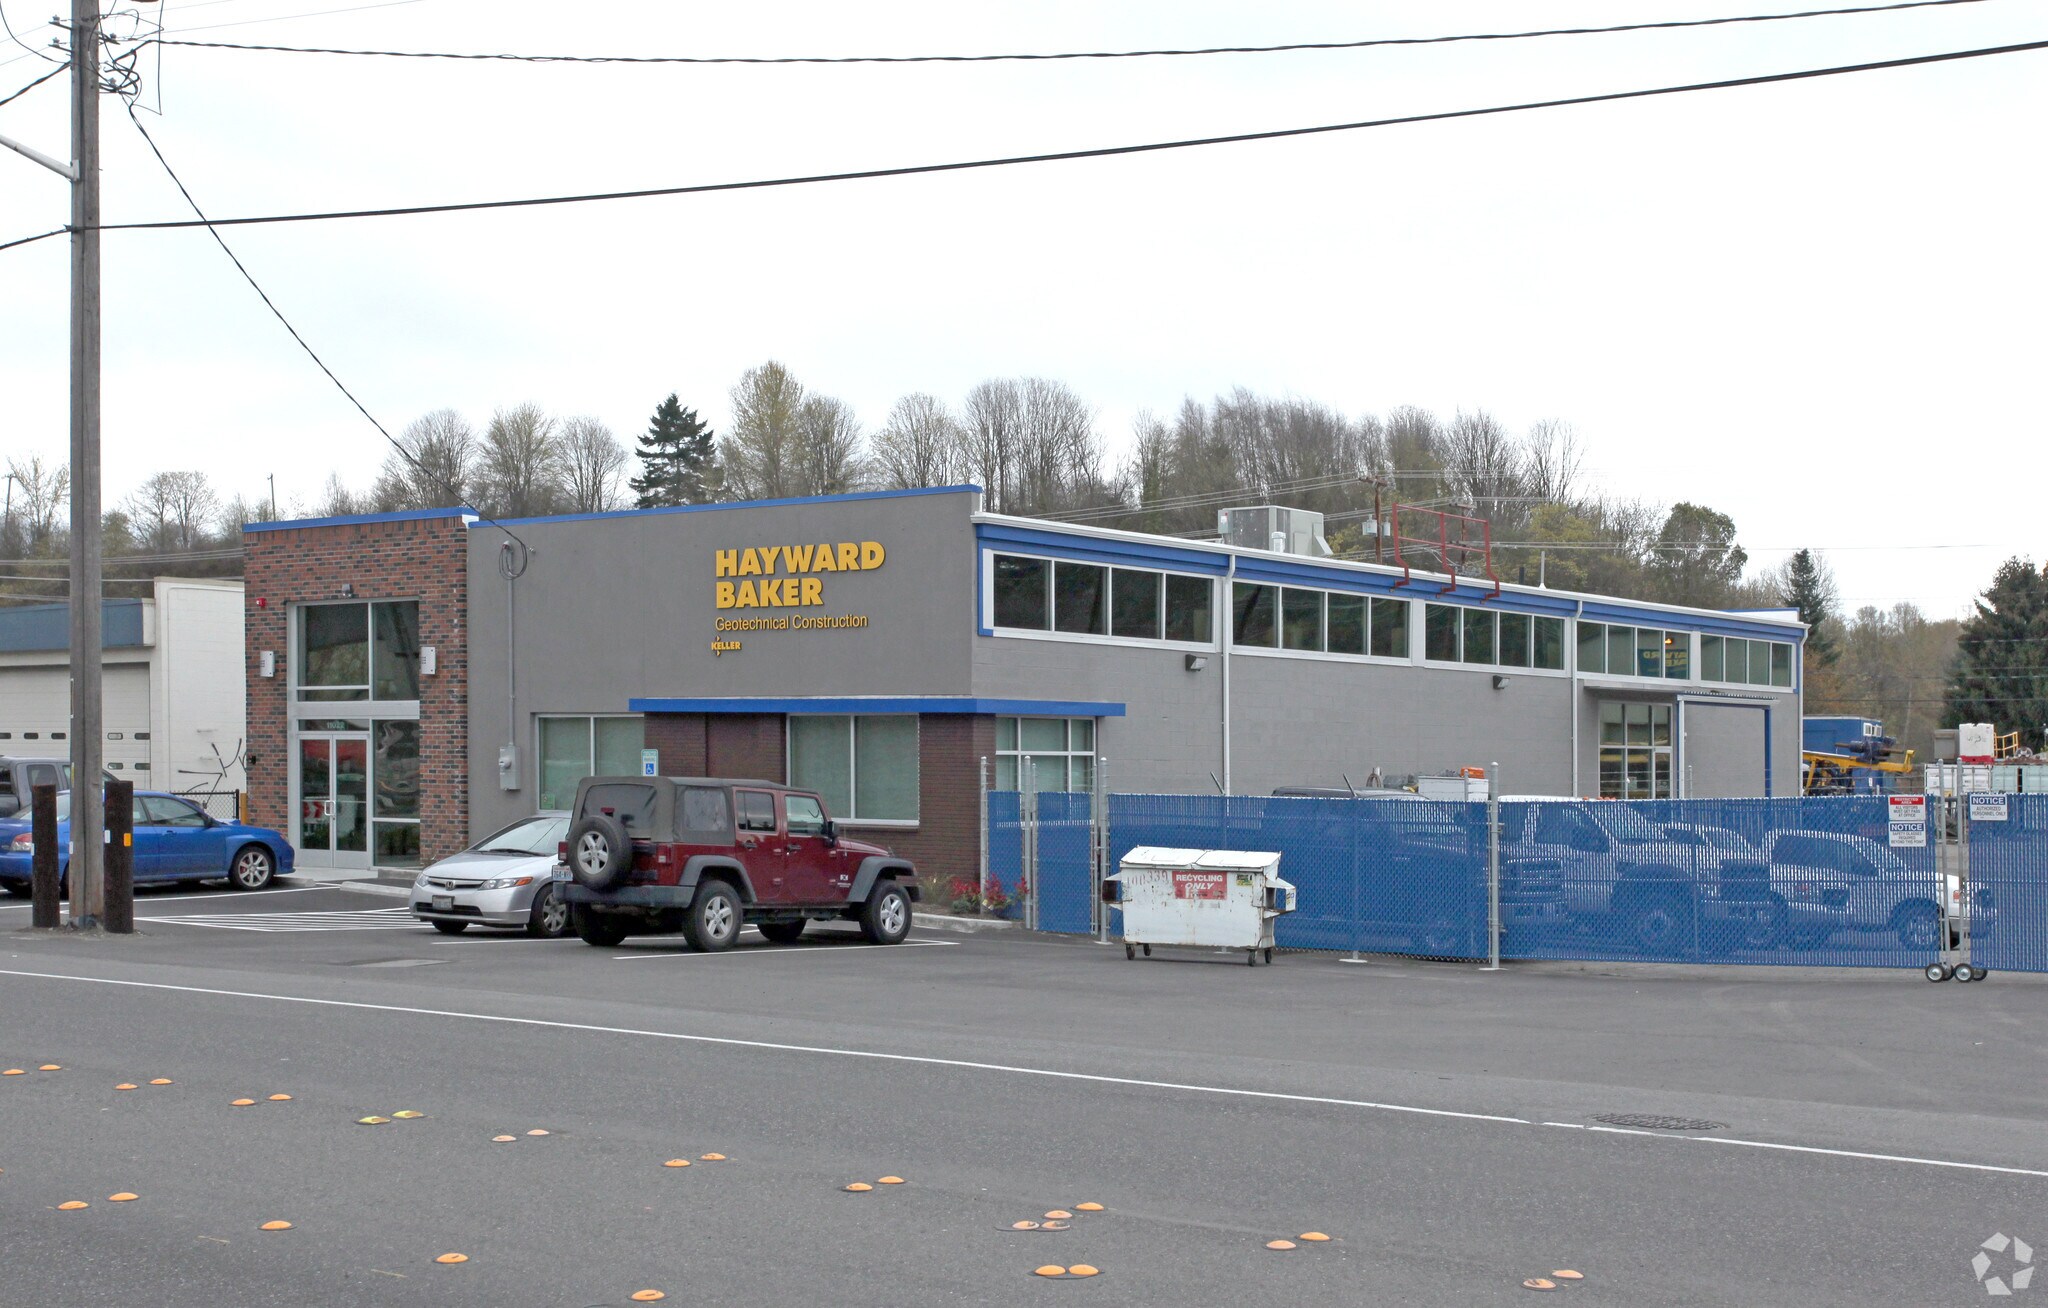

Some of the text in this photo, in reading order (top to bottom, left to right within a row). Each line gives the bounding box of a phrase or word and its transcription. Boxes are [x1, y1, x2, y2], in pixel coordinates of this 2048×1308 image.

[716, 541, 886, 577] HAYWARD
[716, 578, 824, 609] BAKER
[715, 614, 868, 631] Geotechnical Construction
[711, 641, 742, 651] KELLER
[1176, 874, 1223, 882] RECYCLING
[1185, 882, 1215, 890] ONLY
